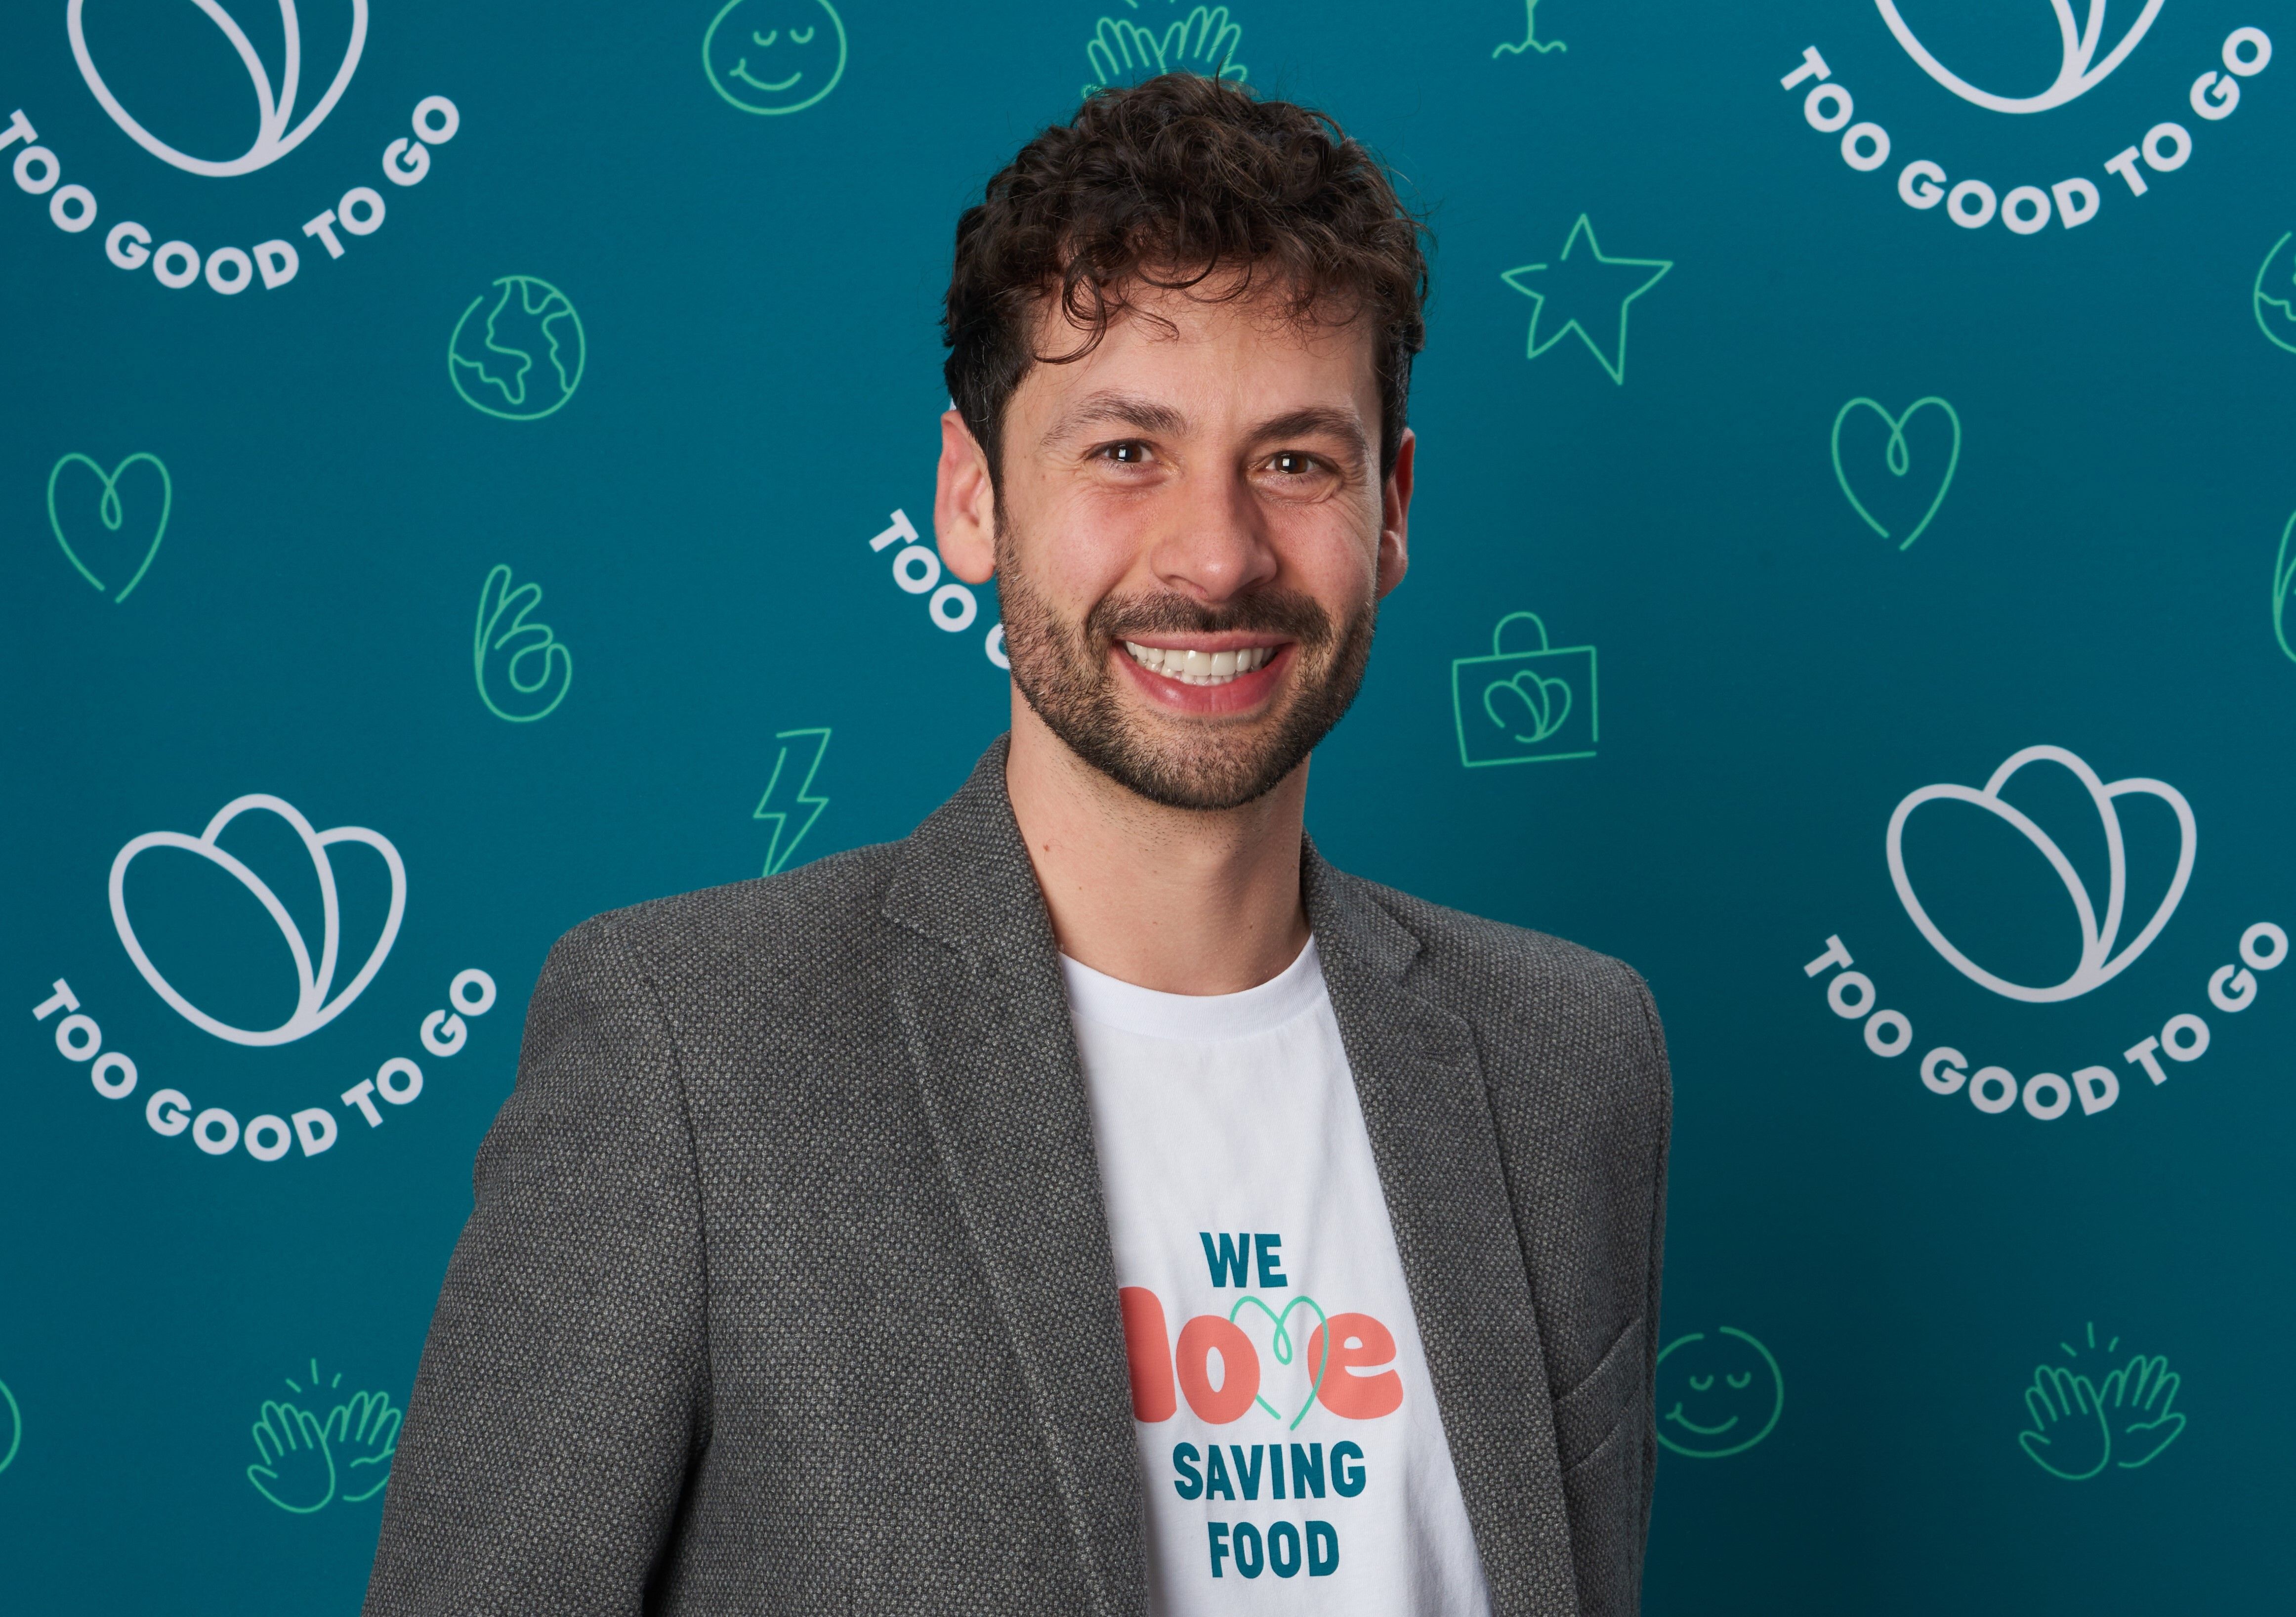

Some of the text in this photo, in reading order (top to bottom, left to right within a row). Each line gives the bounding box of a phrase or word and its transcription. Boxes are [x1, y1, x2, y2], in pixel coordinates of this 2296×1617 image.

[0, 95, 460, 296] TOO GOOD TO GO
[1780, 27, 2272, 235] TOO GOOD TO GO
[869, 509, 978, 633] TOO
[32, 968, 497, 1162] TOO GOOD TO GO
[1803, 922, 2288, 1121] TOO GOOD TO GO
[1199, 1232, 1288, 1288] WE
[1172, 1441, 1367, 1501] SAVING
[1207, 1520, 1339, 1579] FOOD
